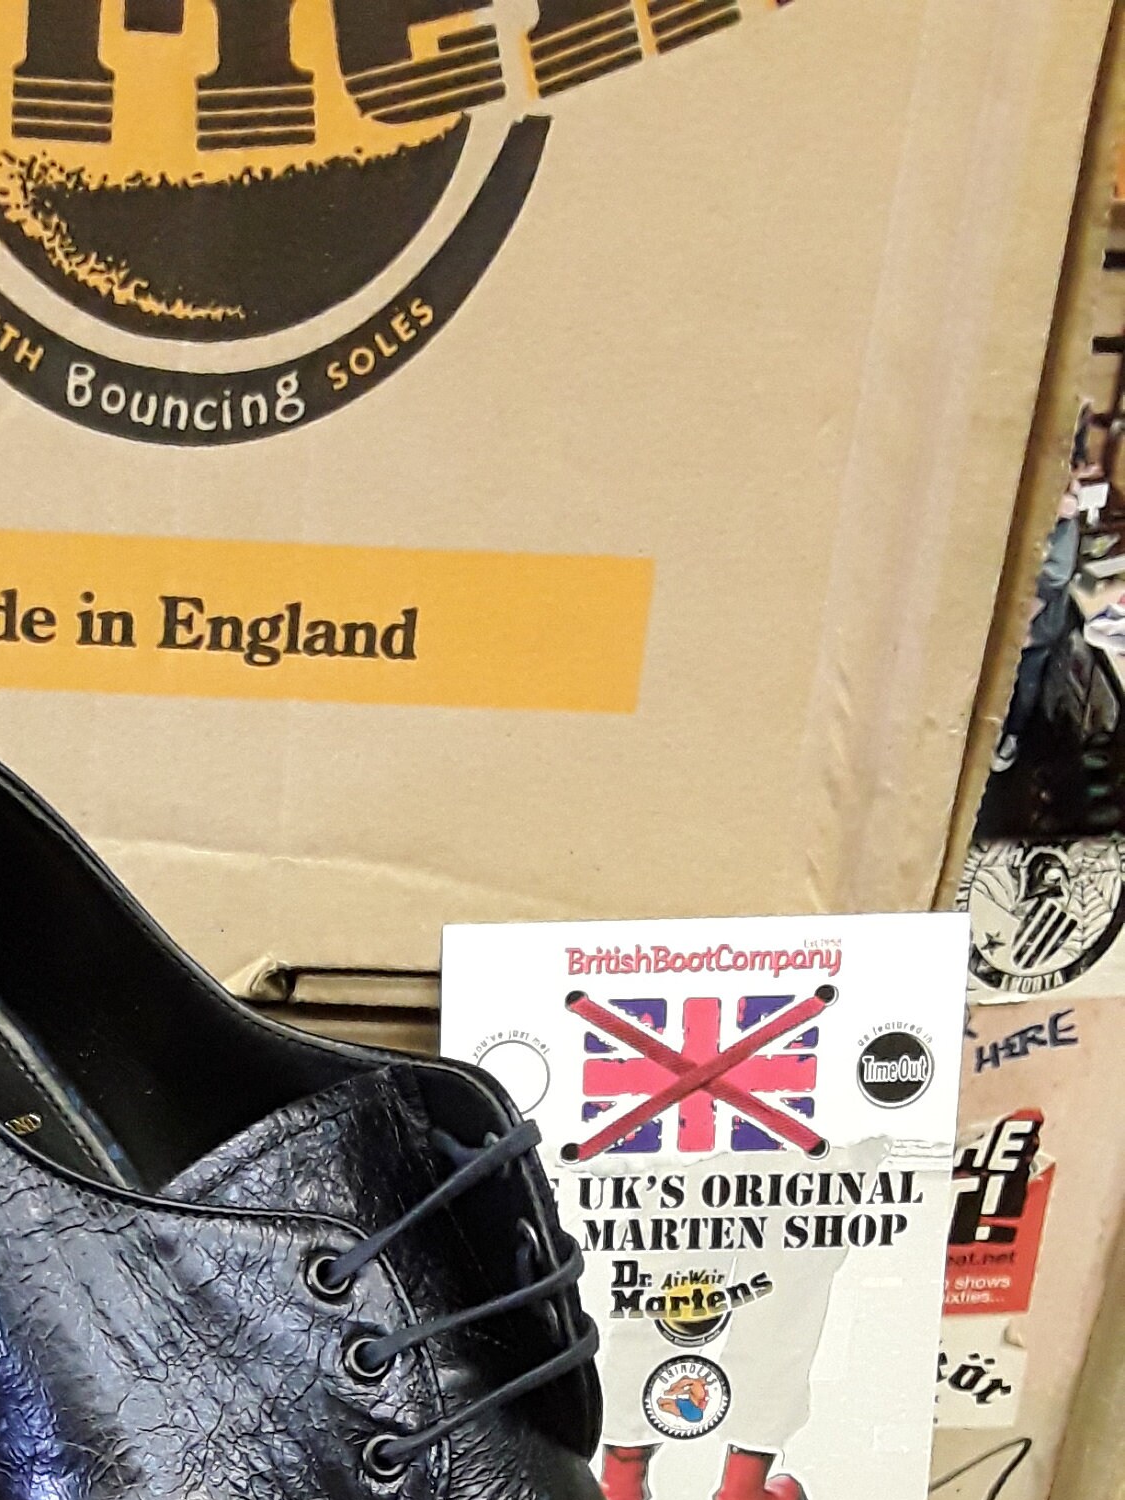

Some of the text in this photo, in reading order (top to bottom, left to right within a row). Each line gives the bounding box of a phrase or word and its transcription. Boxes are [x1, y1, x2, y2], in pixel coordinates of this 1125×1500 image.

[65, 361, 306, 432] Bouncing
[326, 297, 434, 392] SOLES
[76, 591, 137, 649] in
[157, 594, 420, 668] England
[578, 1174, 686, 1210] UK'S
[701, 1169, 924, 1210] ORIGINAL
[581, 1212, 909, 1253] MARTEN SHOP
[610, 1259, 653, 1288] Dr.
[661, 1268, 726, 1291] AirWair
[954, 1275, 1012, 1290] shows
[609, 1271, 774, 1319] Martens
